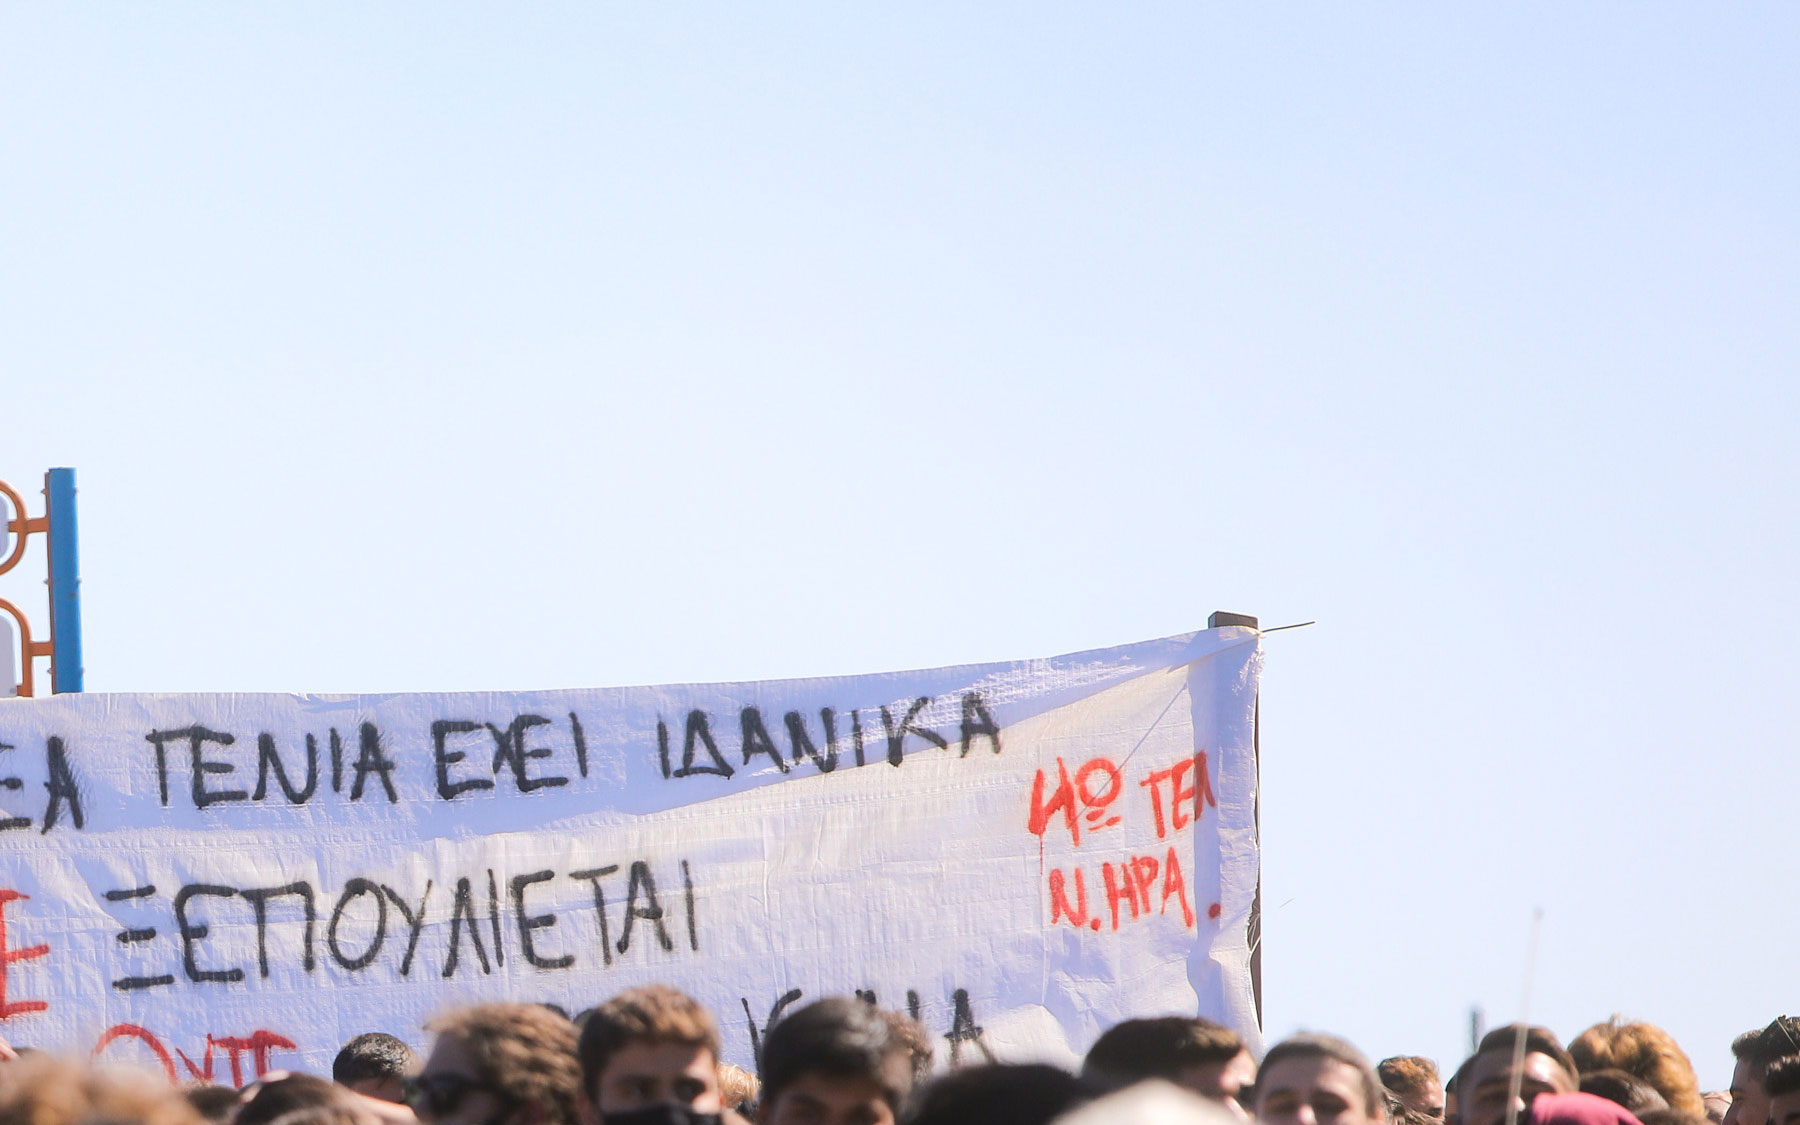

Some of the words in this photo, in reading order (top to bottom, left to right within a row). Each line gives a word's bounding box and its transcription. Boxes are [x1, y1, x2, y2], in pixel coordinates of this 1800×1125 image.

[145, 720, 398, 809] ΓΕΝΙΑ
[431, 711, 589, 800] ΕΧΕΙ
[657, 692, 1003, 781] ΙΔΑΝΙΚΑ
[101, 859, 701, 991] ΞΕΠΟΥΛΙΕΤΑΙ
